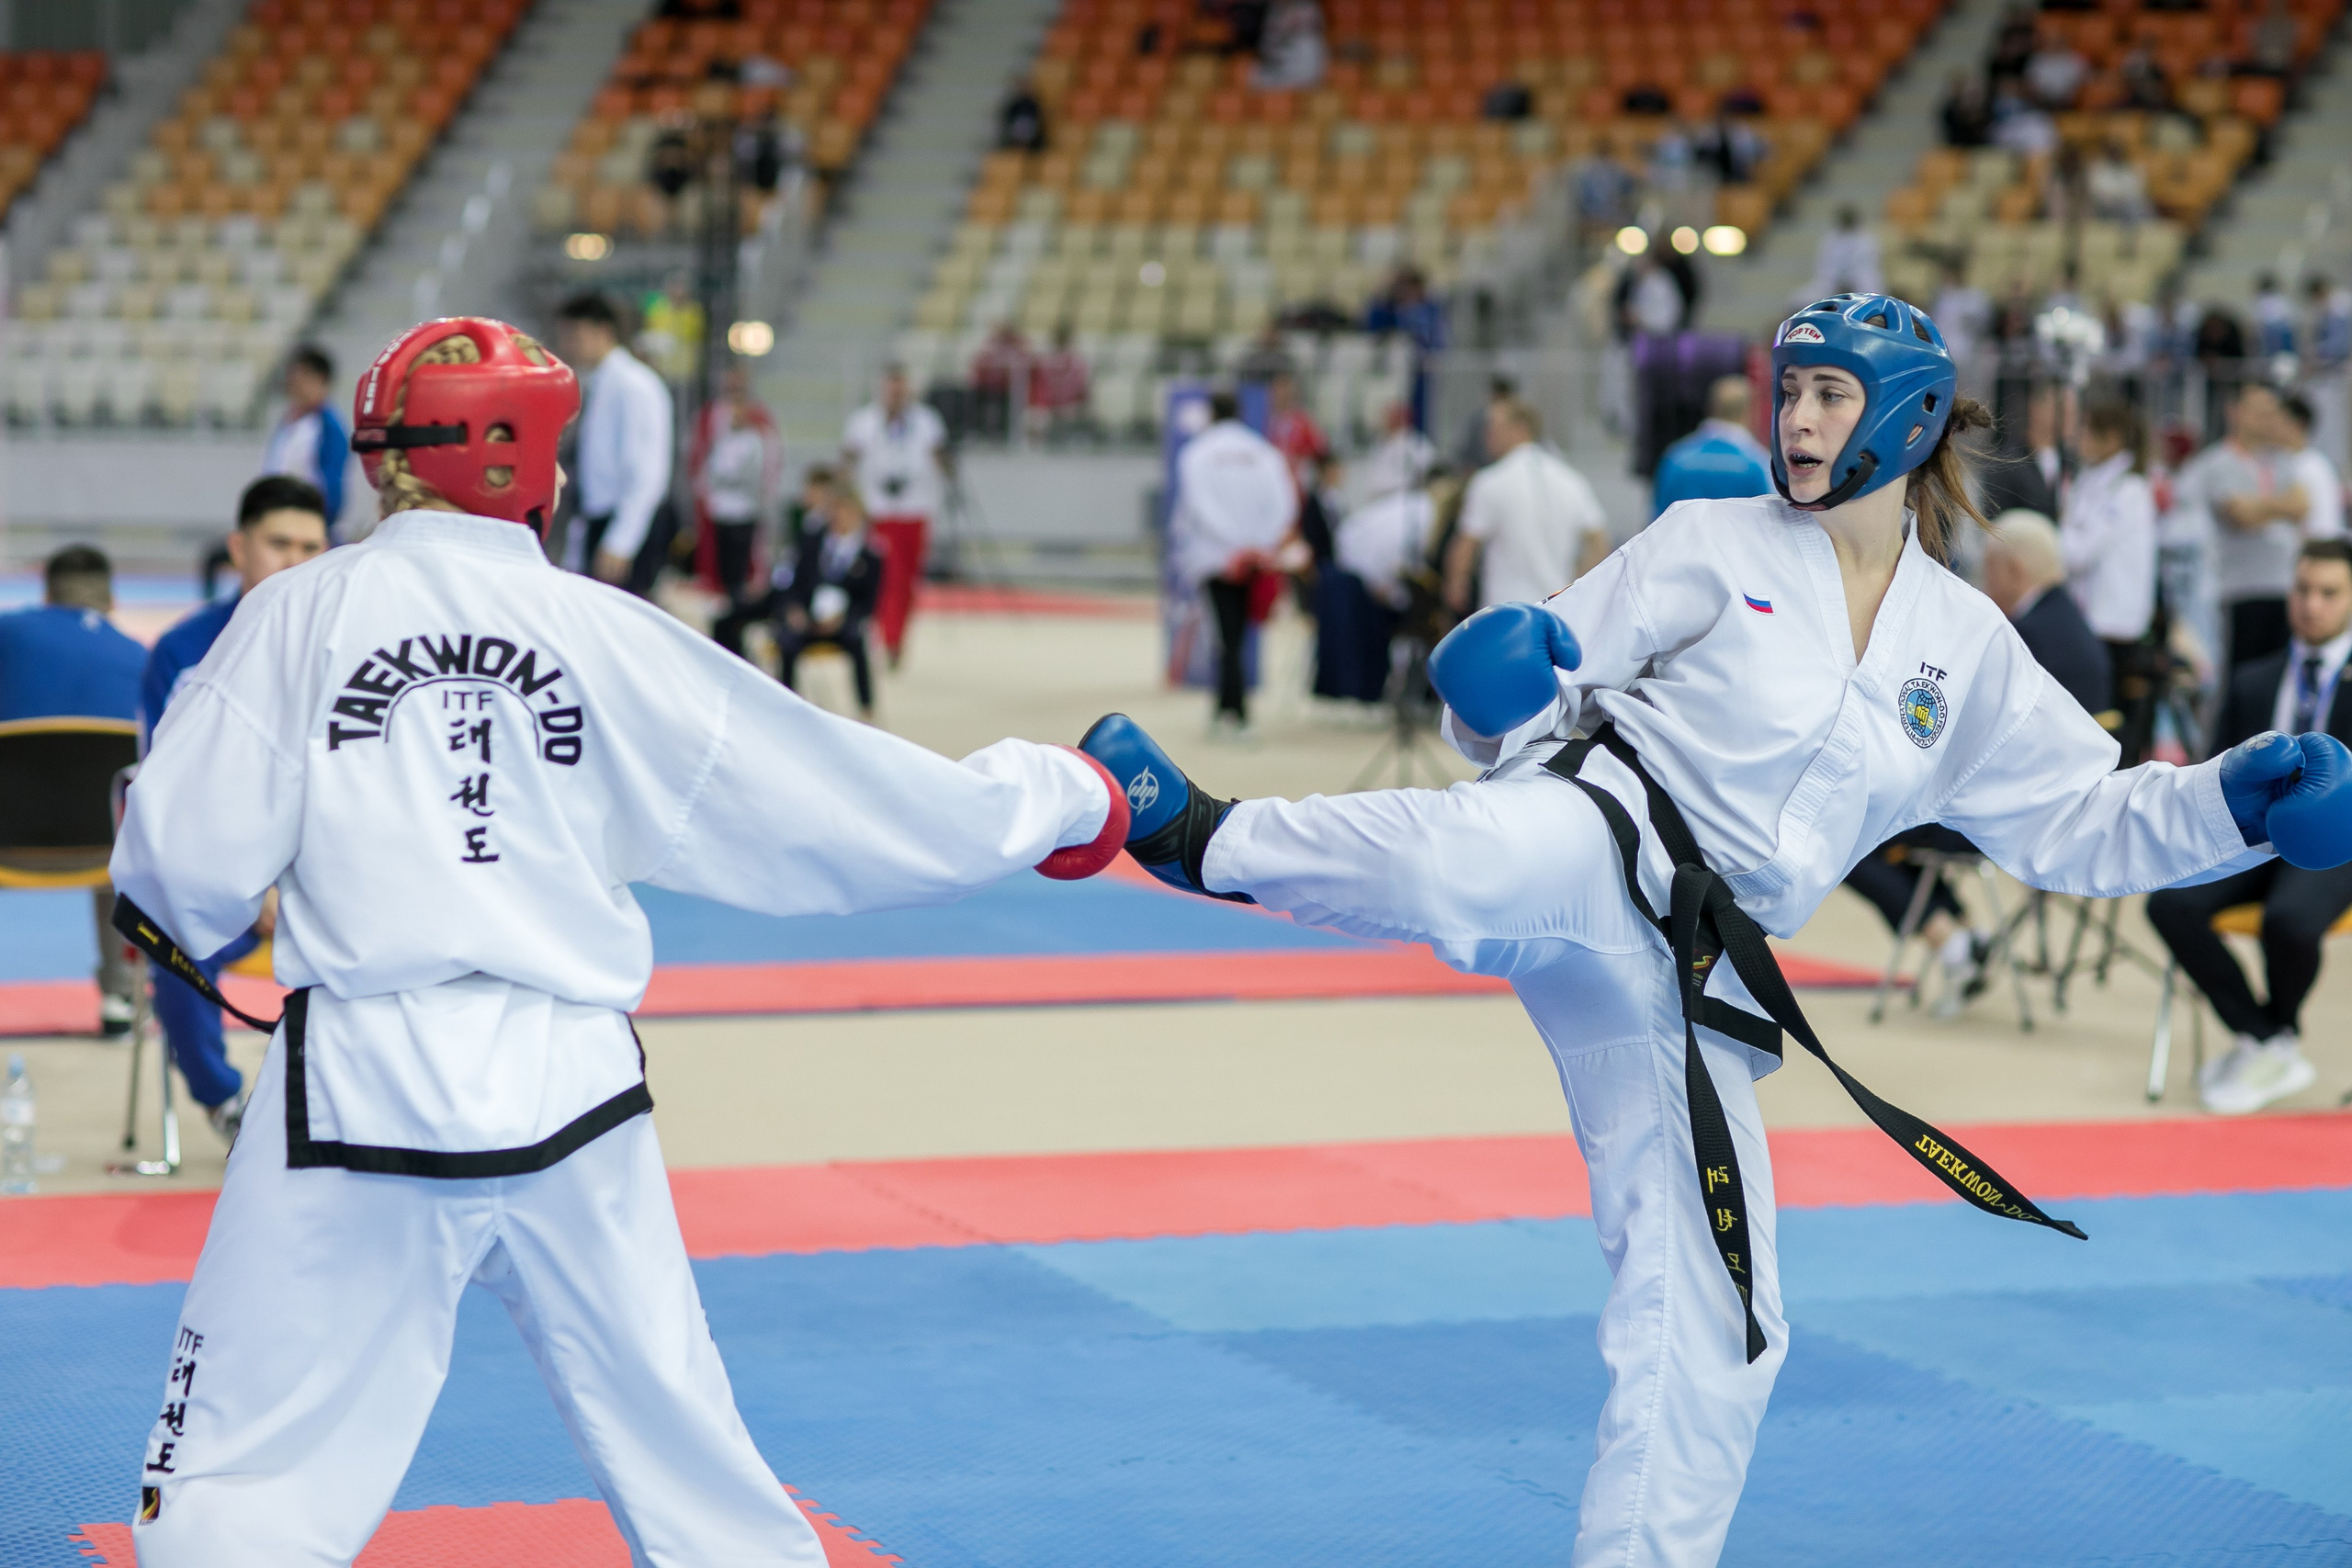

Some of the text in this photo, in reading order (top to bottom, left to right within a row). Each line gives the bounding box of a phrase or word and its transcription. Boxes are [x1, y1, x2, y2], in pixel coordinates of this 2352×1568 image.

[1788, 327, 1822, 340] TOP TEN
[1919, 661, 1947, 681] ITF
[327, 634, 583, 766] TAEKWON-DO
[443, 690, 493, 711] ITF
[448, 717, 500, 863] 태권도
[177, 1325, 204, 1356] ITF
